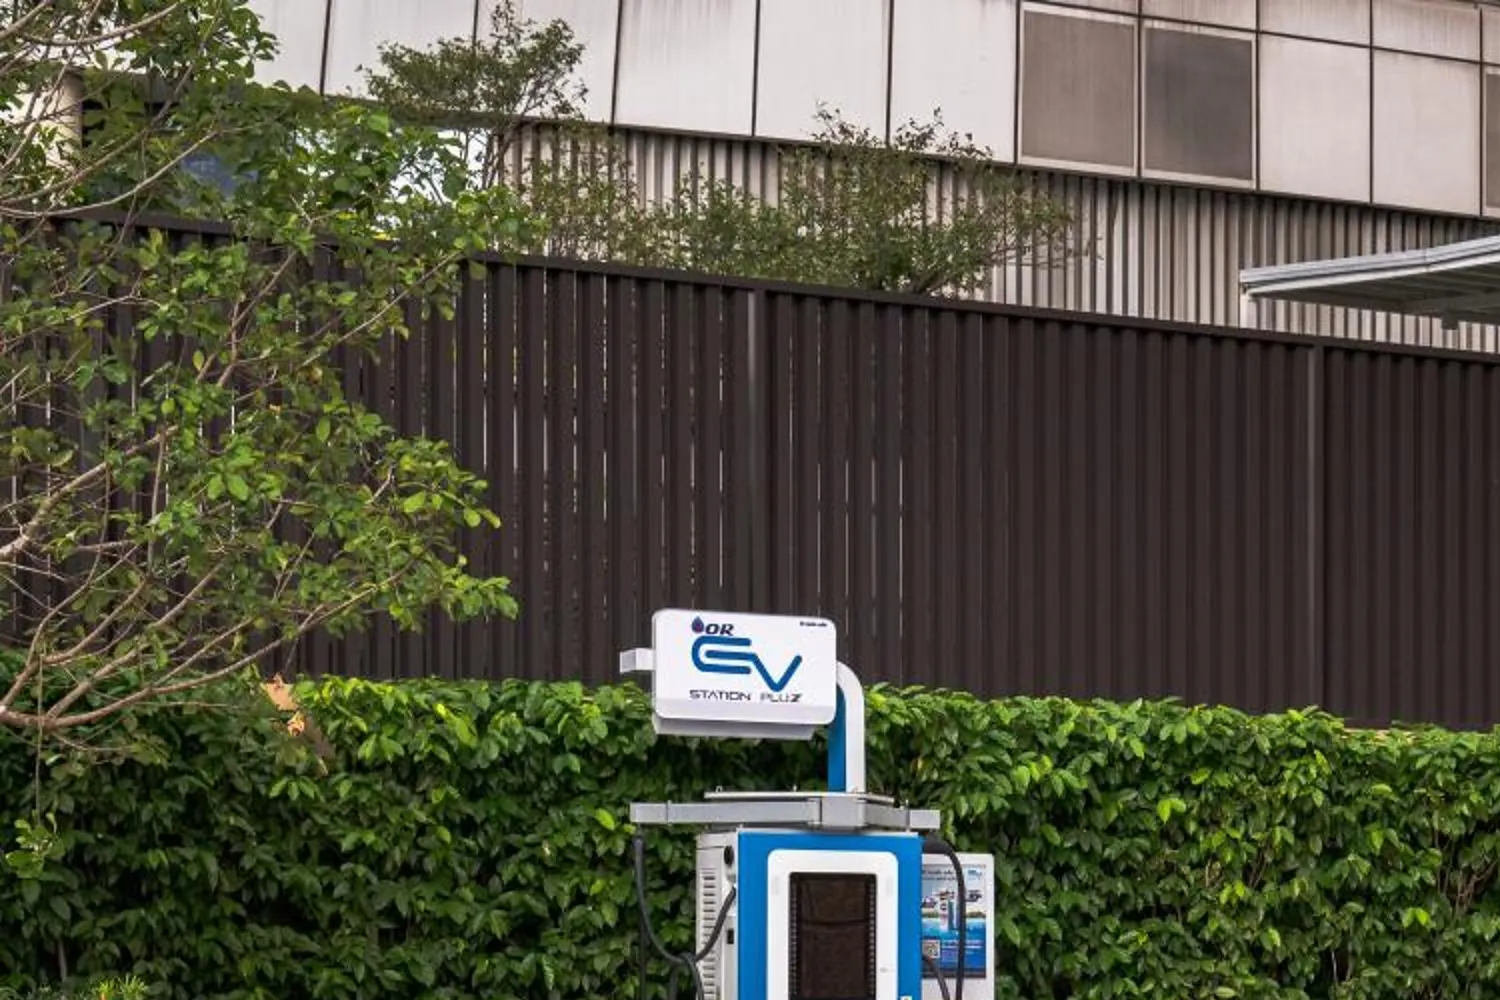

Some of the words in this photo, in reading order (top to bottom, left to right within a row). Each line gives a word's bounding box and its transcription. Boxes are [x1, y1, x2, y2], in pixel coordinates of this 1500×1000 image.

[706, 623, 734, 635] OR
[691, 635, 802, 692] EV
[689, 689, 751, 701] STATION
